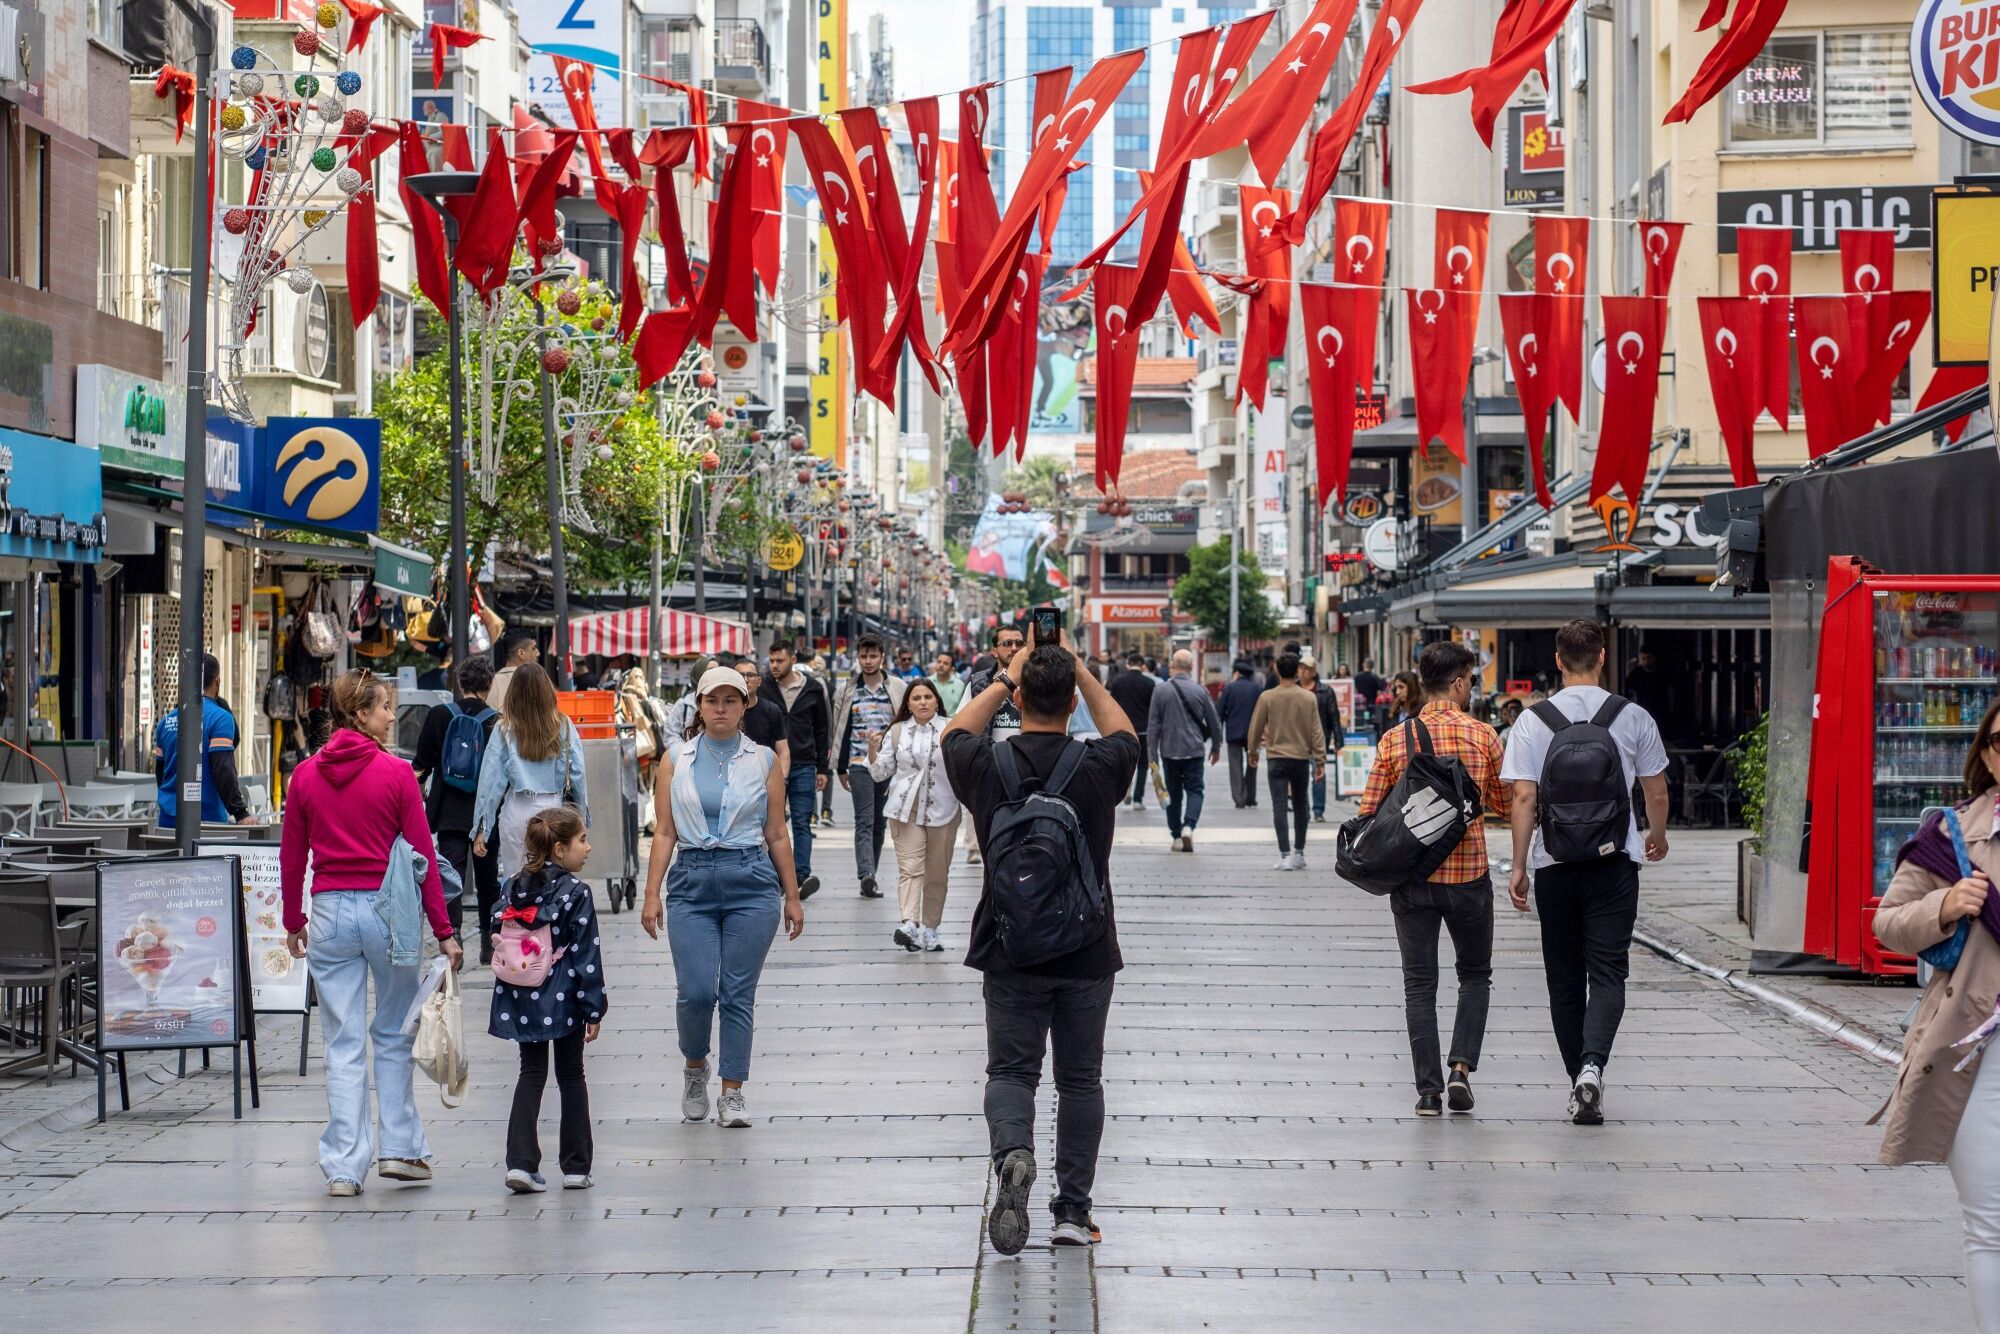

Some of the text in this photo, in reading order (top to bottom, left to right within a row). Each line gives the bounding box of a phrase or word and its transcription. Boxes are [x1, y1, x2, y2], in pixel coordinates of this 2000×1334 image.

[1940, 4, 2000, 51] BUR
[1746, 66, 1802, 82] DUDAK
[1941, 39, 2000, 97] KI
[1737, 88, 1811, 104] DOLGUSU
[1506, 190, 1537, 201] LION
[1746, 187, 1911, 246] clinic
[1354, 407, 1381, 418] PUK
[205, 437, 241, 492] URKCELL
[242, 863, 279, 872] zsüt'ün
[254, 873, 280, 882] lezze
[166, 898, 224, 910] doğal lezzet
[154, 1020, 186, 1031] ÖZSÜT
